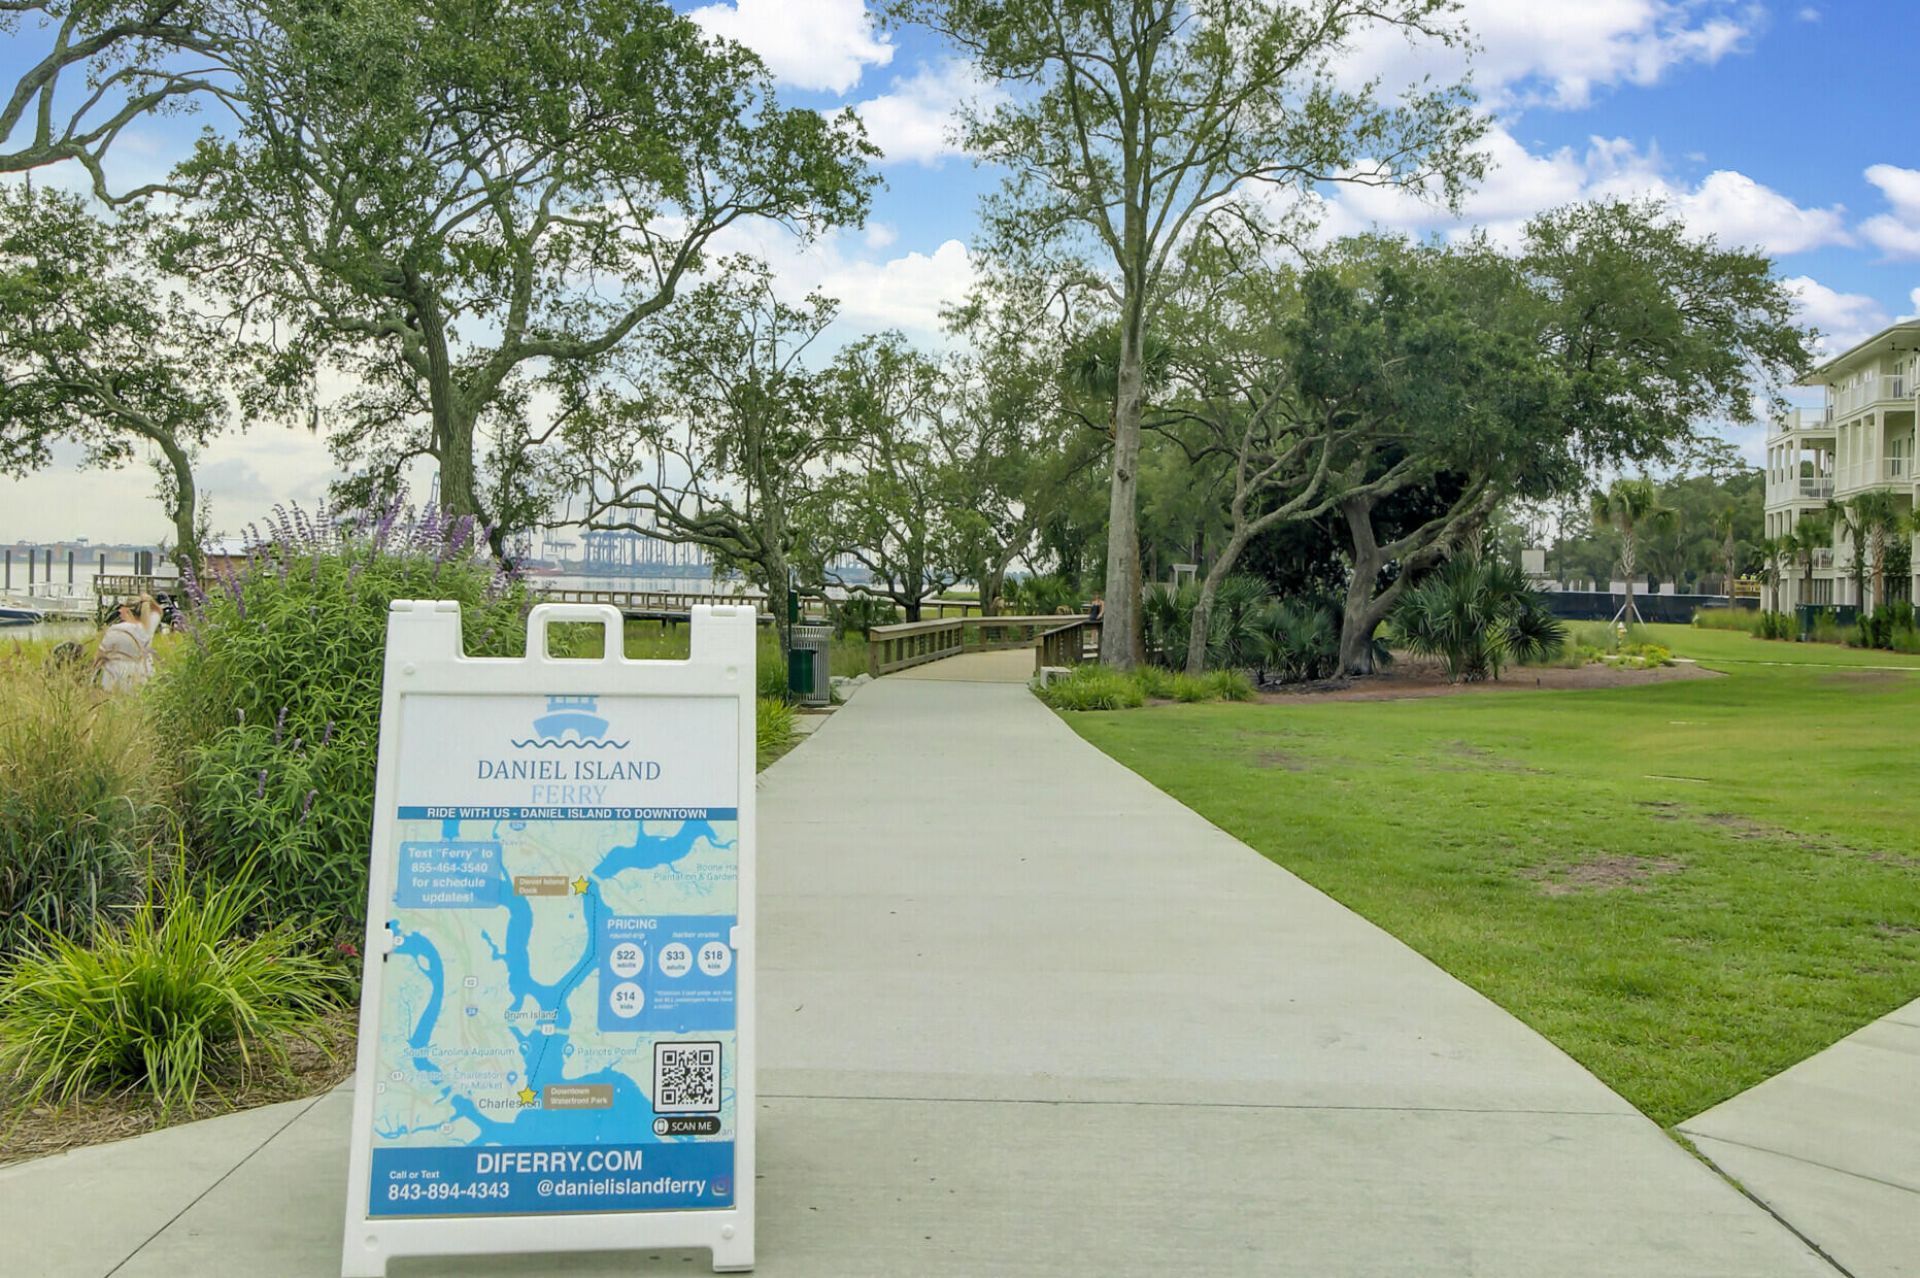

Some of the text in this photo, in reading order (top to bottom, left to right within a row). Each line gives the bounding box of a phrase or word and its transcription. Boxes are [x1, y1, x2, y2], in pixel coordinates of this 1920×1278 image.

[477, 760, 661, 780] DANIEL ISLAND
[531, 784, 608, 804] FERRY
[427, 808, 456, 818] RIDE
[459, 808, 491, 818] WITH
[493, 808, 510, 818] US
[520, 808, 564, 818] DANIEL
[568, 808, 612, 819] ISLAND
[615, 809, 631, 819] TO
[634, 809, 707, 819] DOWNTOWN
[408, 848, 433, 858] Text
[482, 848, 493, 858] to
[412, 863, 488, 873] 855-464-3540
[412, 878, 486, 887] for schedule
[422, 893, 474, 904] updates!
[607, 919, 657, 930] PRICING
[616, 950, 636, 960] $22
[666, 951, 685, 961] $33
[704, 950, 723, 960] $18
[616, 991, 635, 1001] $14
[504, 1011, 557, 1019] Drum Island
[432, 1048, 469, 1056] Carolina
[471, 1048, 515, 1058] Aquarium
[672, 1121, 712, 1131] SCAN ME
[477, 1151, 643, 1174] DIFERRY.COM
[389, 1171, 407, 1179] Call
[421, 1170, 440, 1179] Text
[388, 1182, 510, 1200] 843-894-4343
[537, 1177, 706, 1197] @danielislandferry
